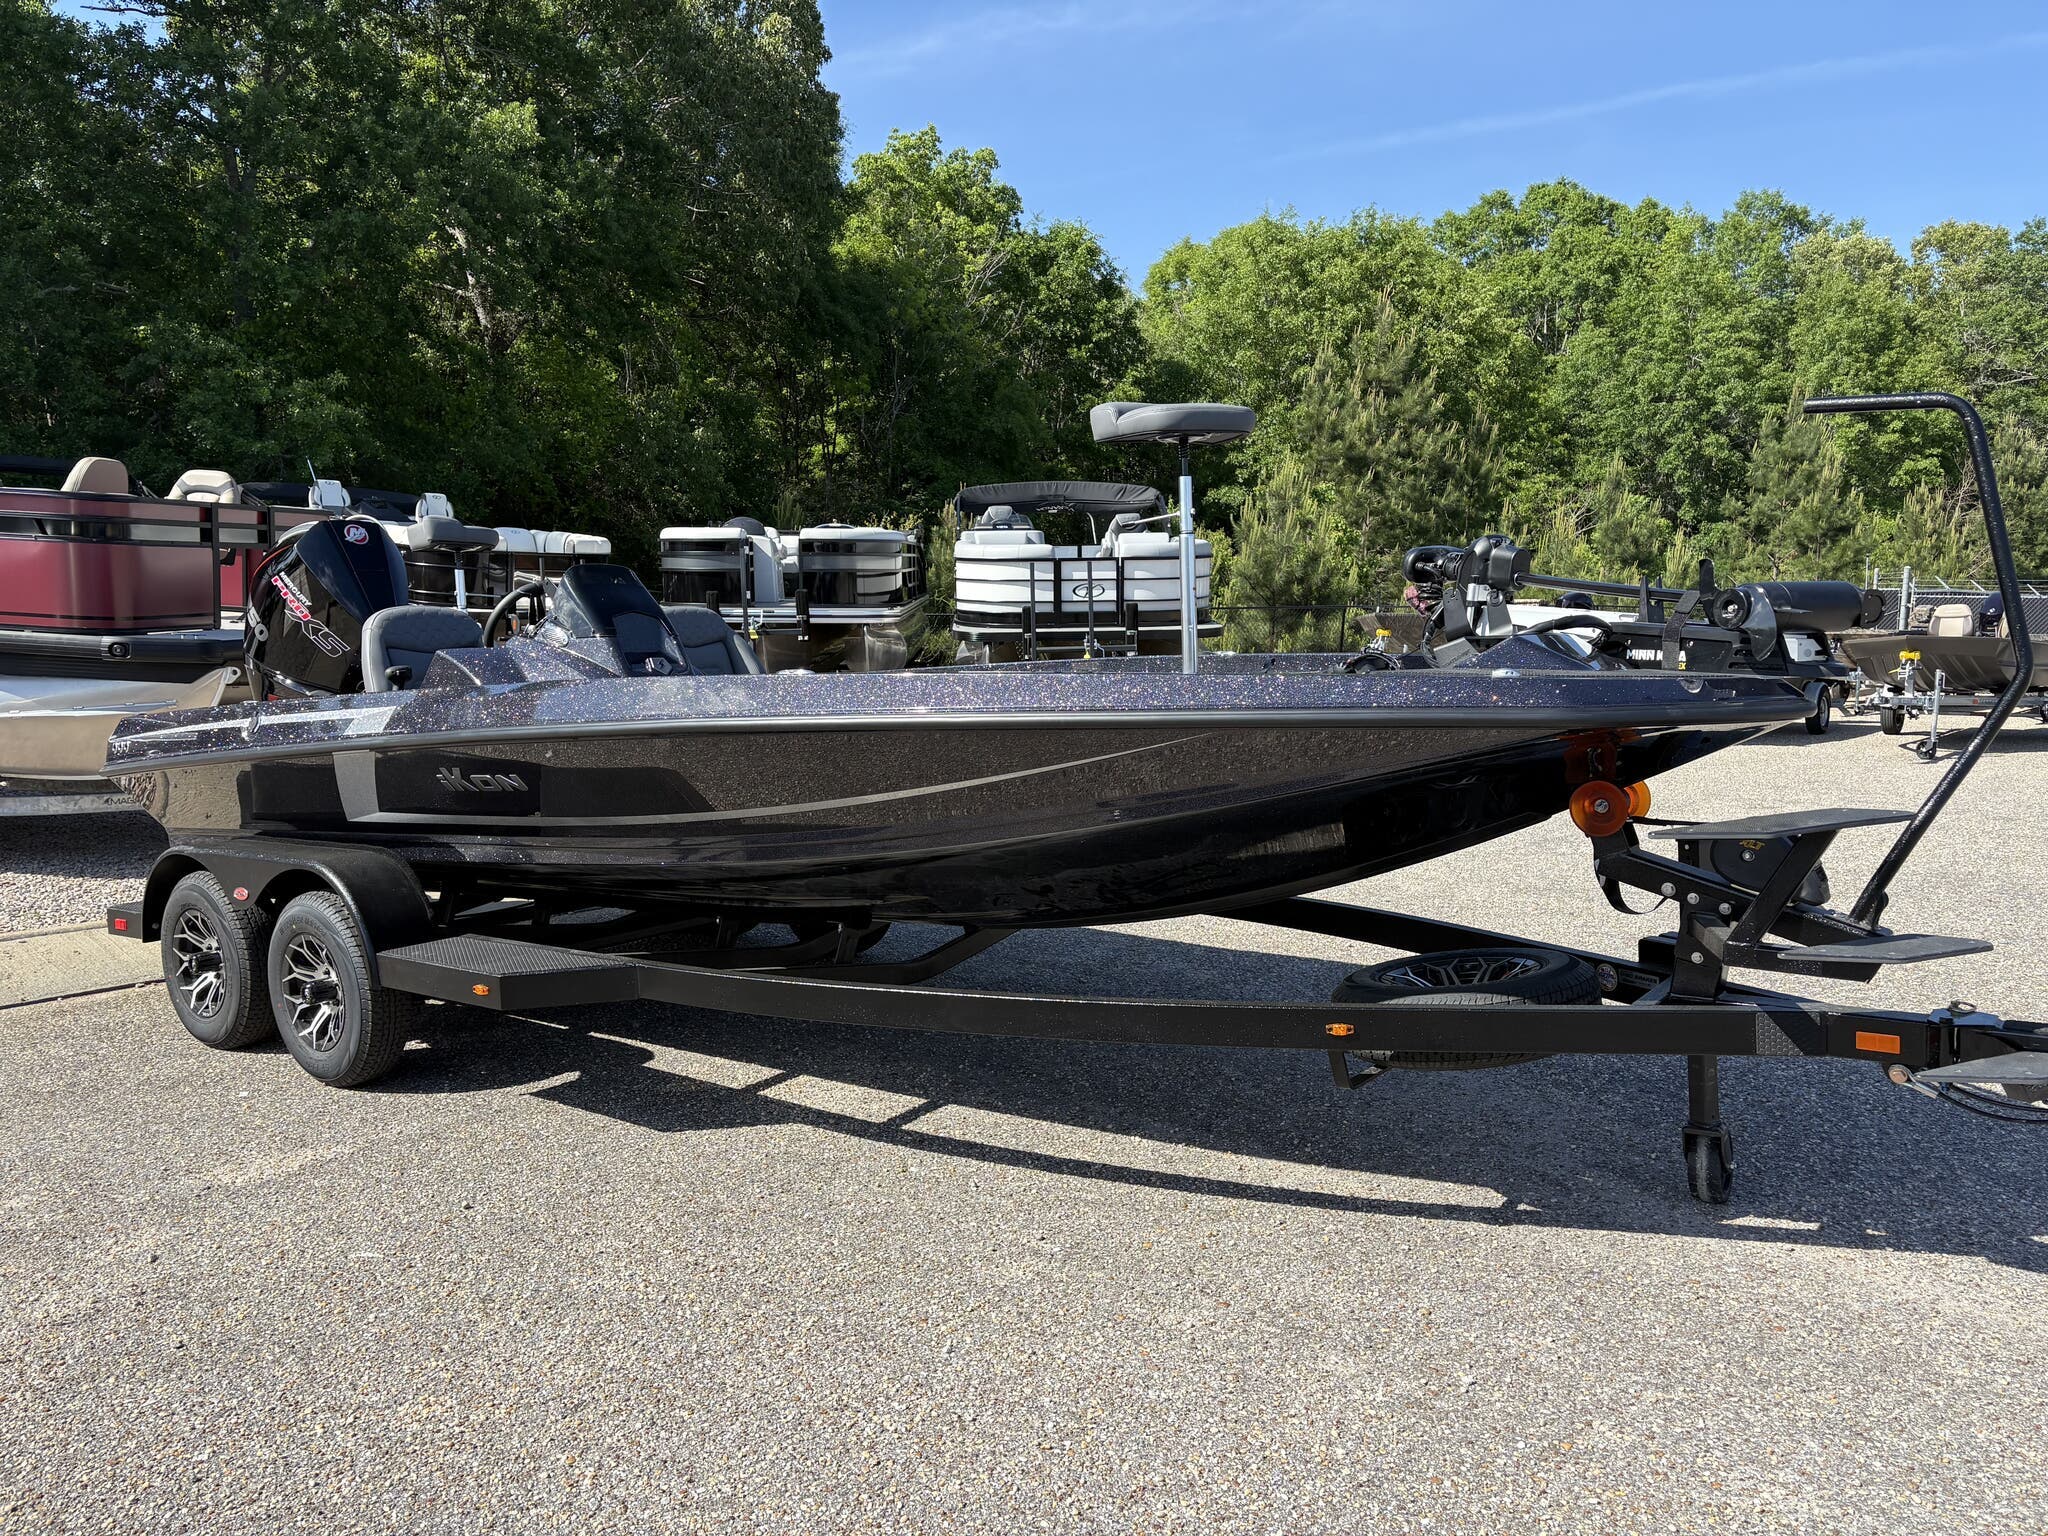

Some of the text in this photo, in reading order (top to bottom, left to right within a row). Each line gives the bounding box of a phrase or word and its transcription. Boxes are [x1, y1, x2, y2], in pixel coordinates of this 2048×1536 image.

[271, 575, 311, 622] PRO
[279, 571, 312, 607] MERCURY
[247, 592, 269, 642] 50
[284, 609, 351, 657] XS
[1626, 649, 1687, 662] MINN KA
